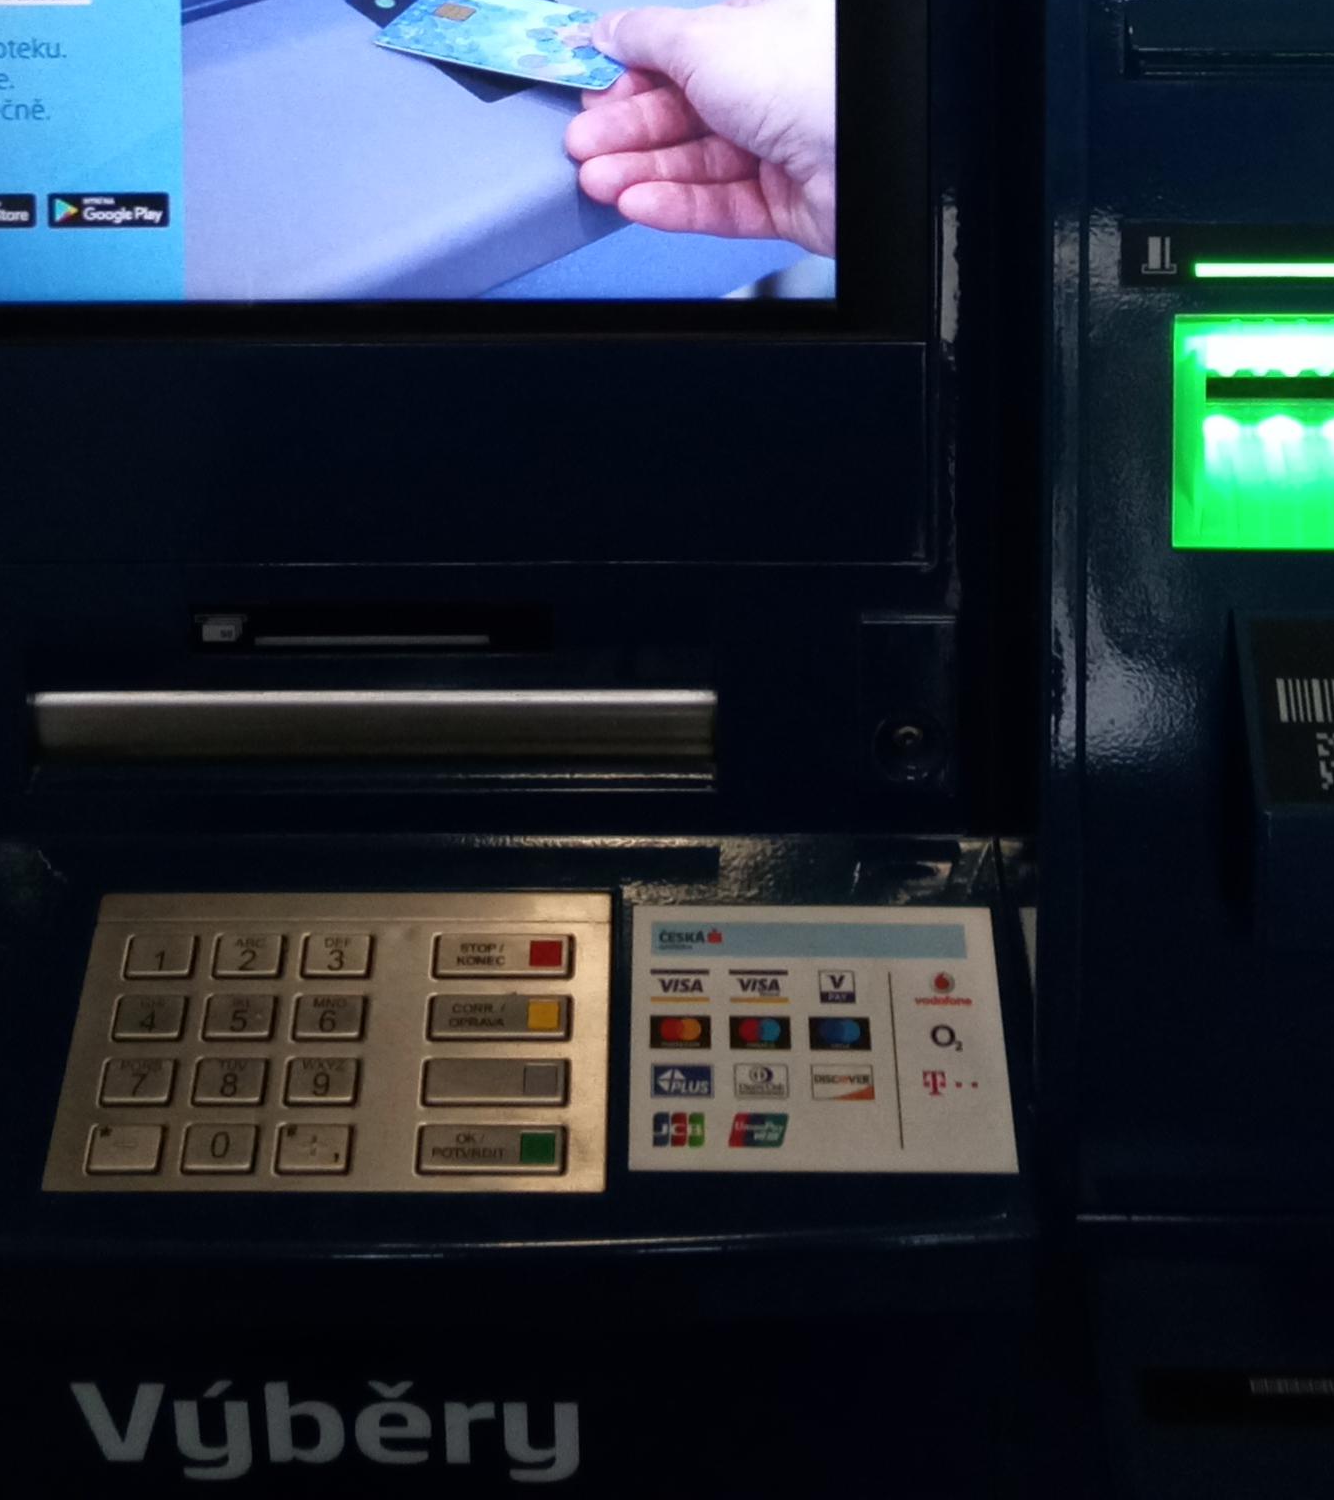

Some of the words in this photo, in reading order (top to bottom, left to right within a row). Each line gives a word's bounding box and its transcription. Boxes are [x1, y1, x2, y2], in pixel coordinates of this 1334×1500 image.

[82, 207, 132, 225] Google
[134, 207, 163, 224] Play
[658, 929, 706, 944] ČESKÁ
[154, 950, 167, 972] 1
[238, 949, 257, 972] 2
[327, 949, 345, 972] 3
[658, 978, 704, 994] VISA
[736, 977, 781, 992] VISA
[827, 974, 846, 990] V
[914, 996, 973, 1006] vodafone
[139, 1010, 156, 1033] 4
[229, 1009, 248, 1032] 5
[319, 1010, 337, 1033] 6
[130, 1072, 148, 1097] 7
[220, 1072, 238, 1097] 8
[312, 1072, 331, 1097] 9
[670, 1078, 710, 1095] PLUS
[210, 1130, 231, 1159] 0
[70, 1379, 580, 1484] Výběry
